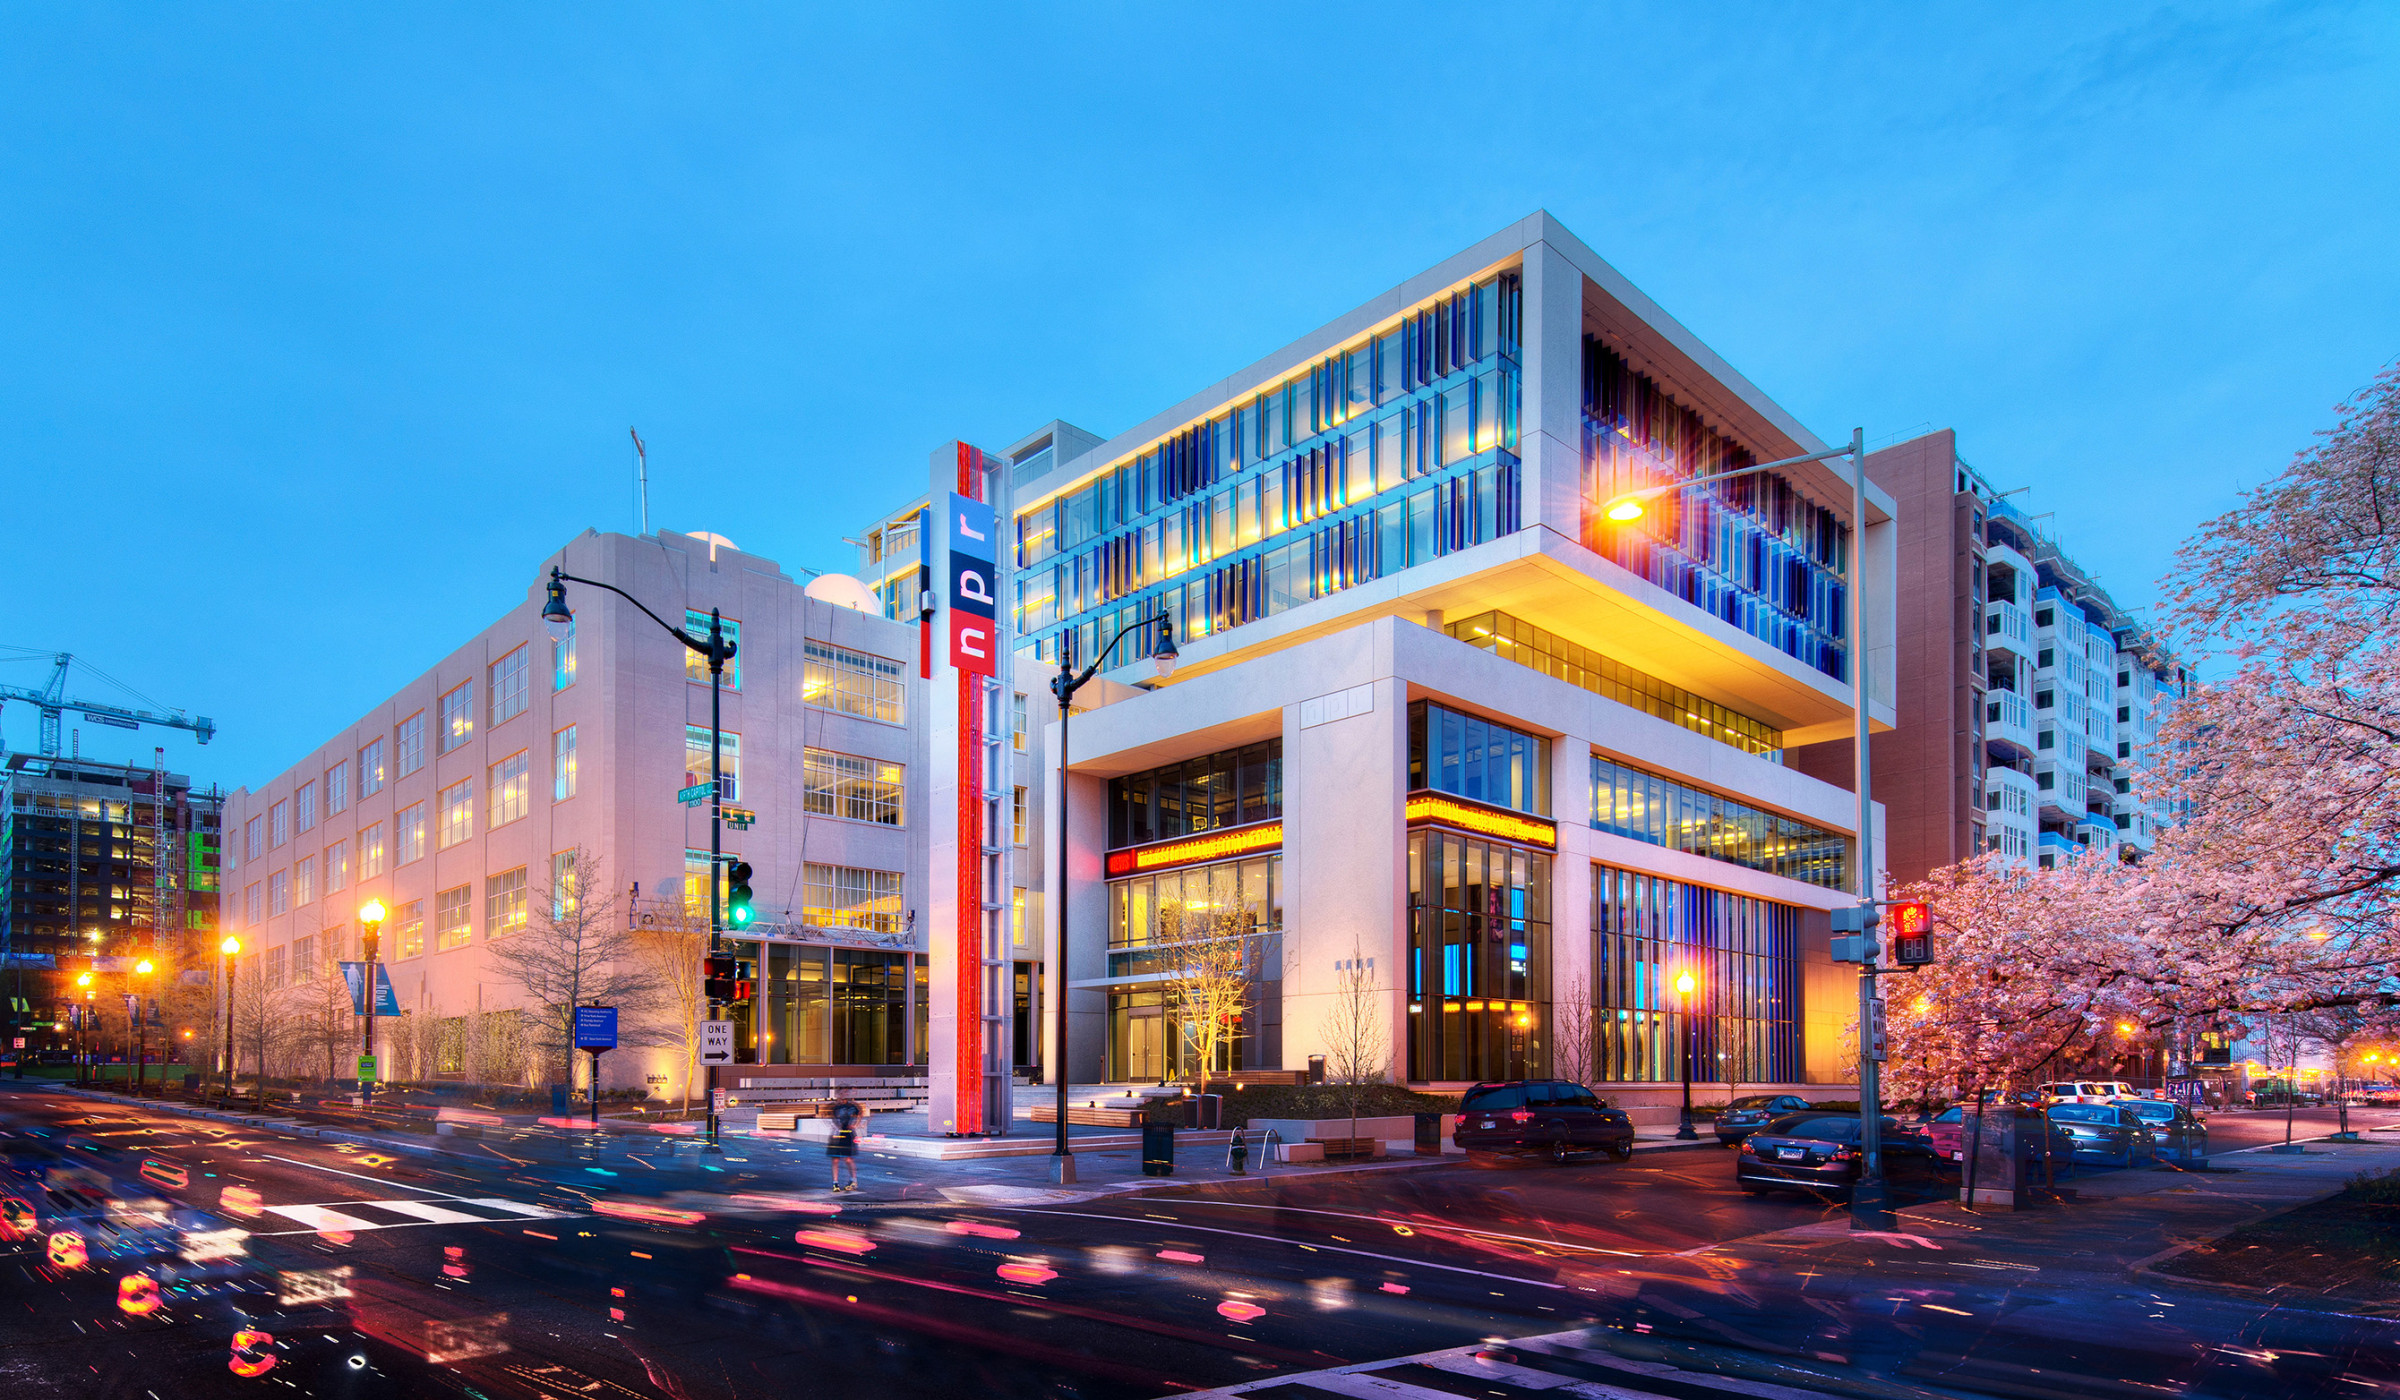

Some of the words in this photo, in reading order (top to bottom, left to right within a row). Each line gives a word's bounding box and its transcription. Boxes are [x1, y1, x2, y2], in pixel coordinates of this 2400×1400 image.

[960, 513, 993, 659] npr
[730, 809, 738, 821] L
[729, 822, 746, 830] UNIT
[1873, 1003, 1884, 1018] ONE
[708, 1025, 727, 1034] ONE
[1873, 1020, 1885, 1034] WAY
[707, 1037, 728, 1046] WAY
